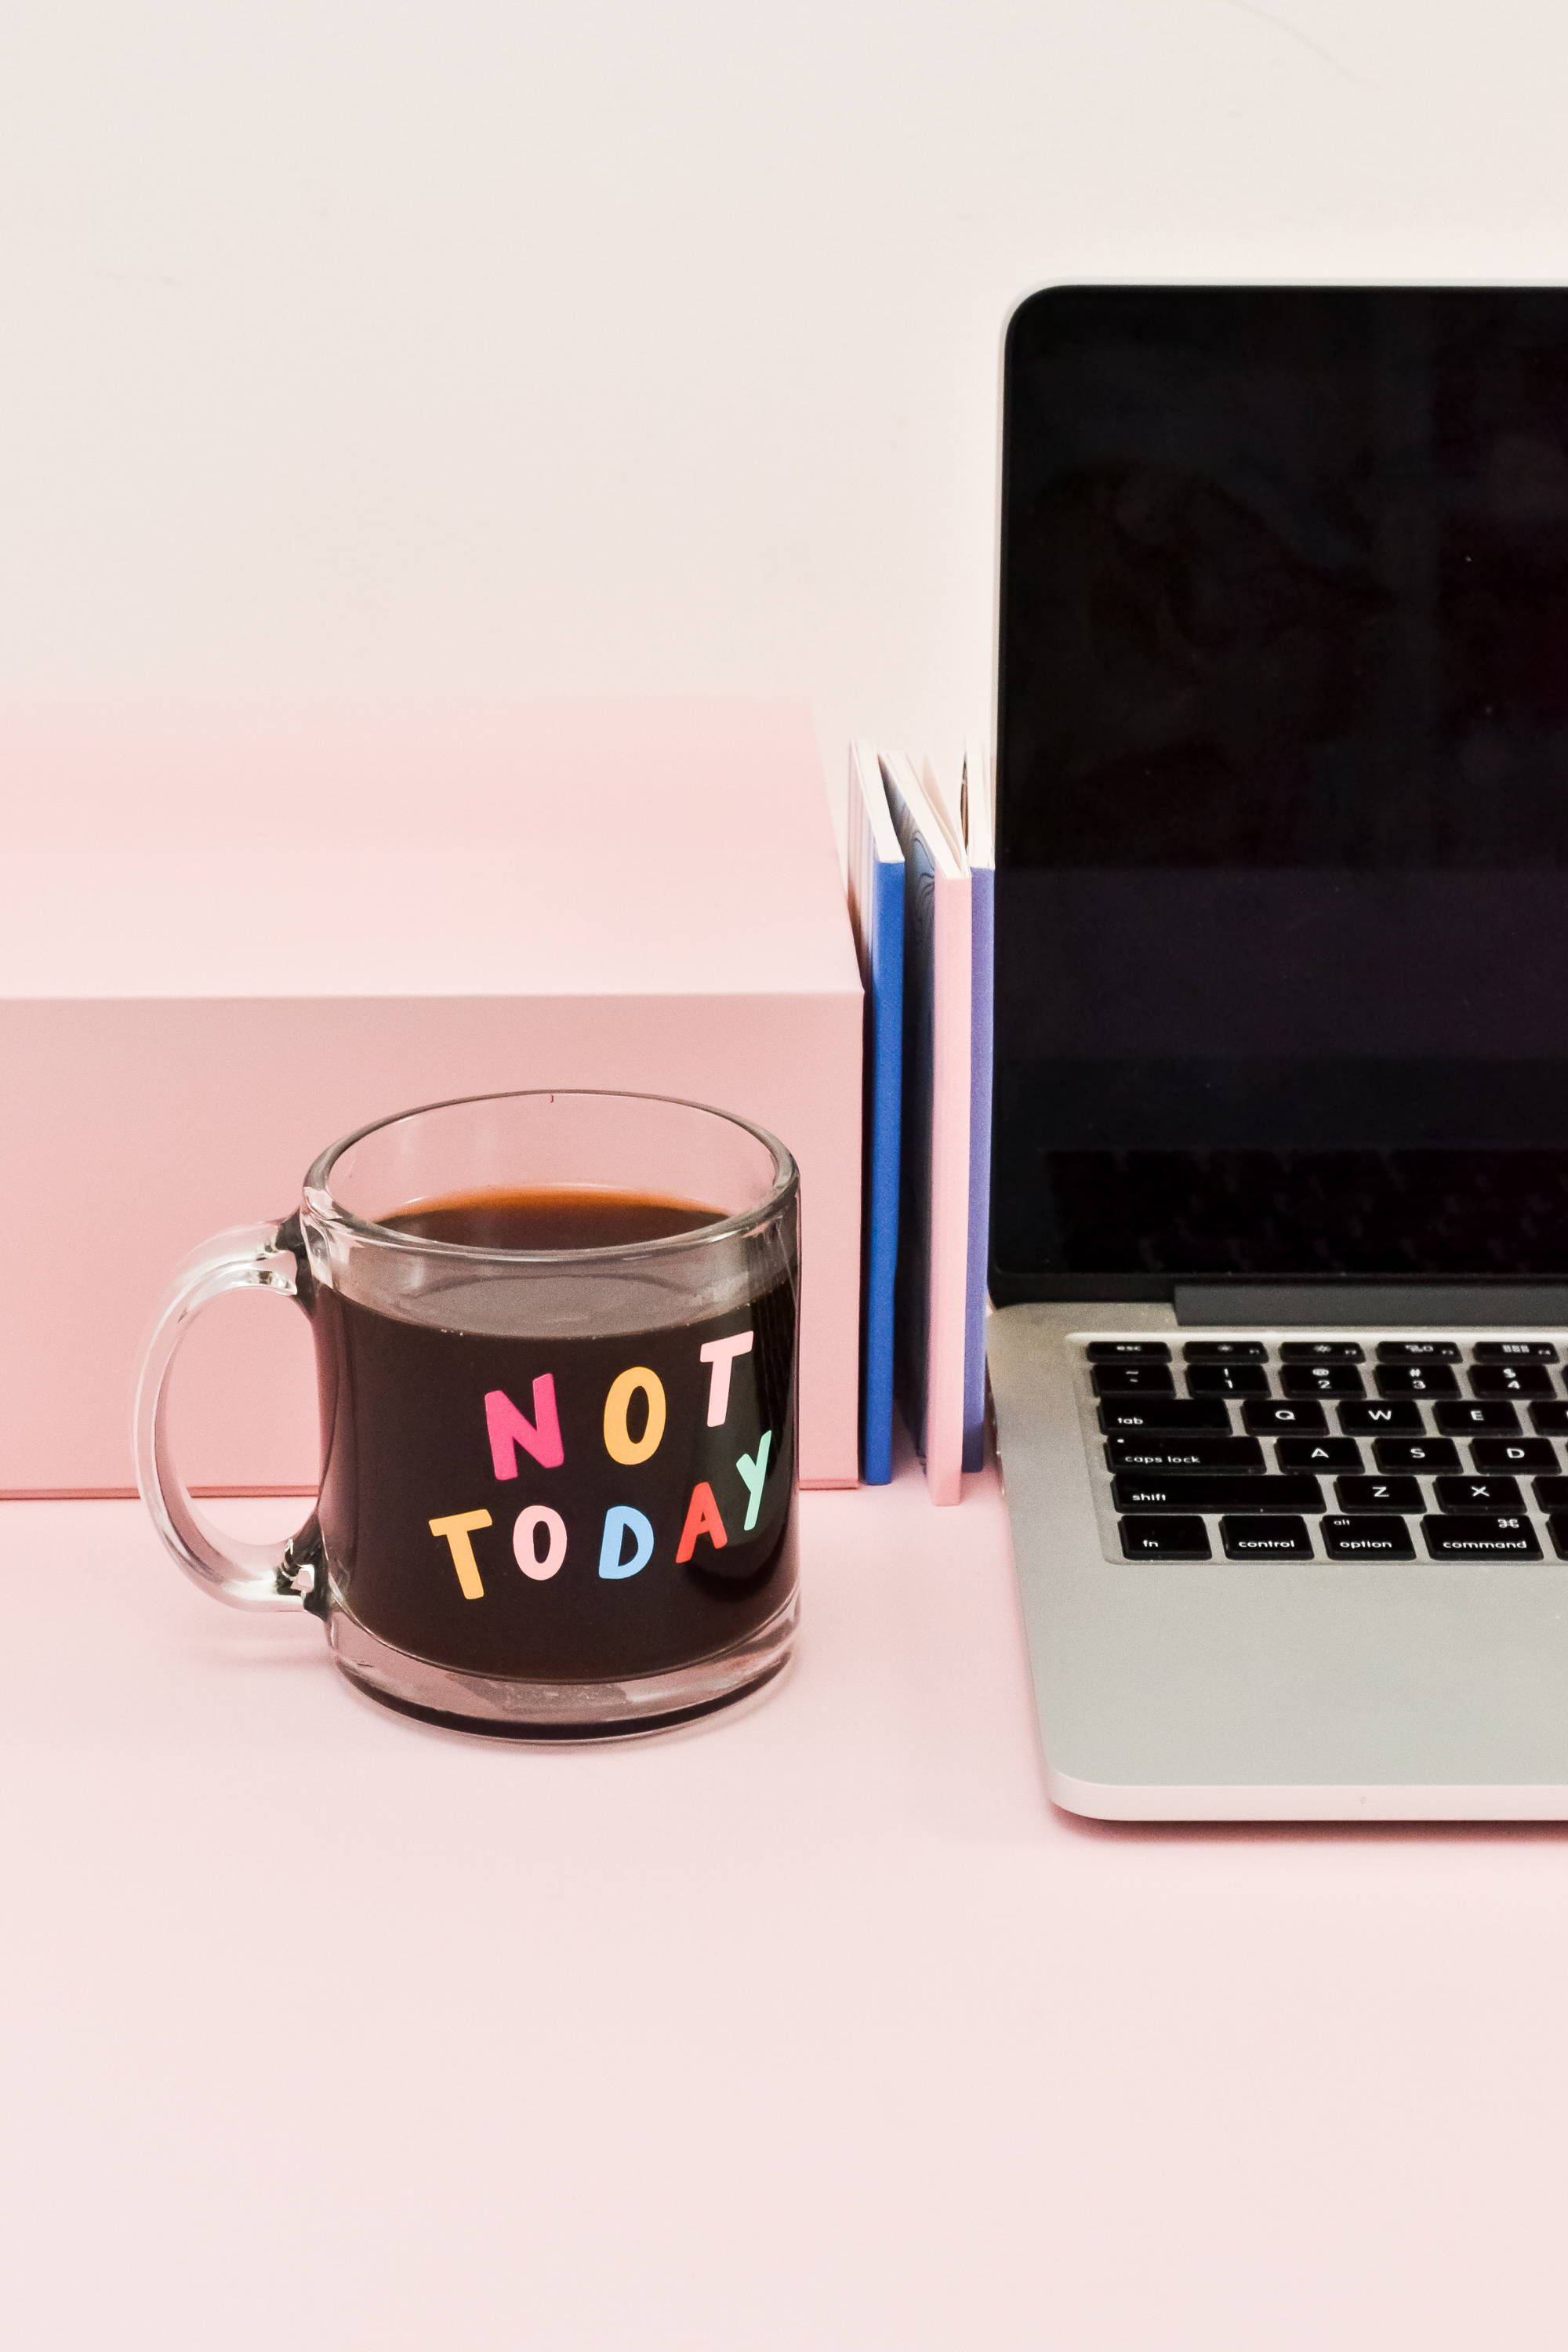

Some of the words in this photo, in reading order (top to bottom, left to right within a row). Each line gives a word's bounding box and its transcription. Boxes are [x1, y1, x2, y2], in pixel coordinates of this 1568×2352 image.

[1225, 1380, 1233, 1388] 1
[1318, 1380, 1331, 1389] 2
[1413, 1380, 1426, 1389] 3
[1508, 1380, 1520, 1389] 4
[485, 1331, 753, 1480] NOT
[1275, 1410, 1295, 1421] Q
[1368, 1410, 1392, 1421] W
[1470, 1410, 1484, 1421] E
[1311, 1447, 1329, 1458] A
[1410, 1448, 1425, 1458] S
[1506, 1447, 1525, 1459] D
[1132, 1493, 1167, 1501] shift
[1372, 1486, 1389, 1497] Z
[1471, 1486, 1490, 1497] X
[429, 1430, 771, 1599] TODAY
[1339, 1541, 1392, 1549] option
[1443, 1540, 1527, 1548] command
